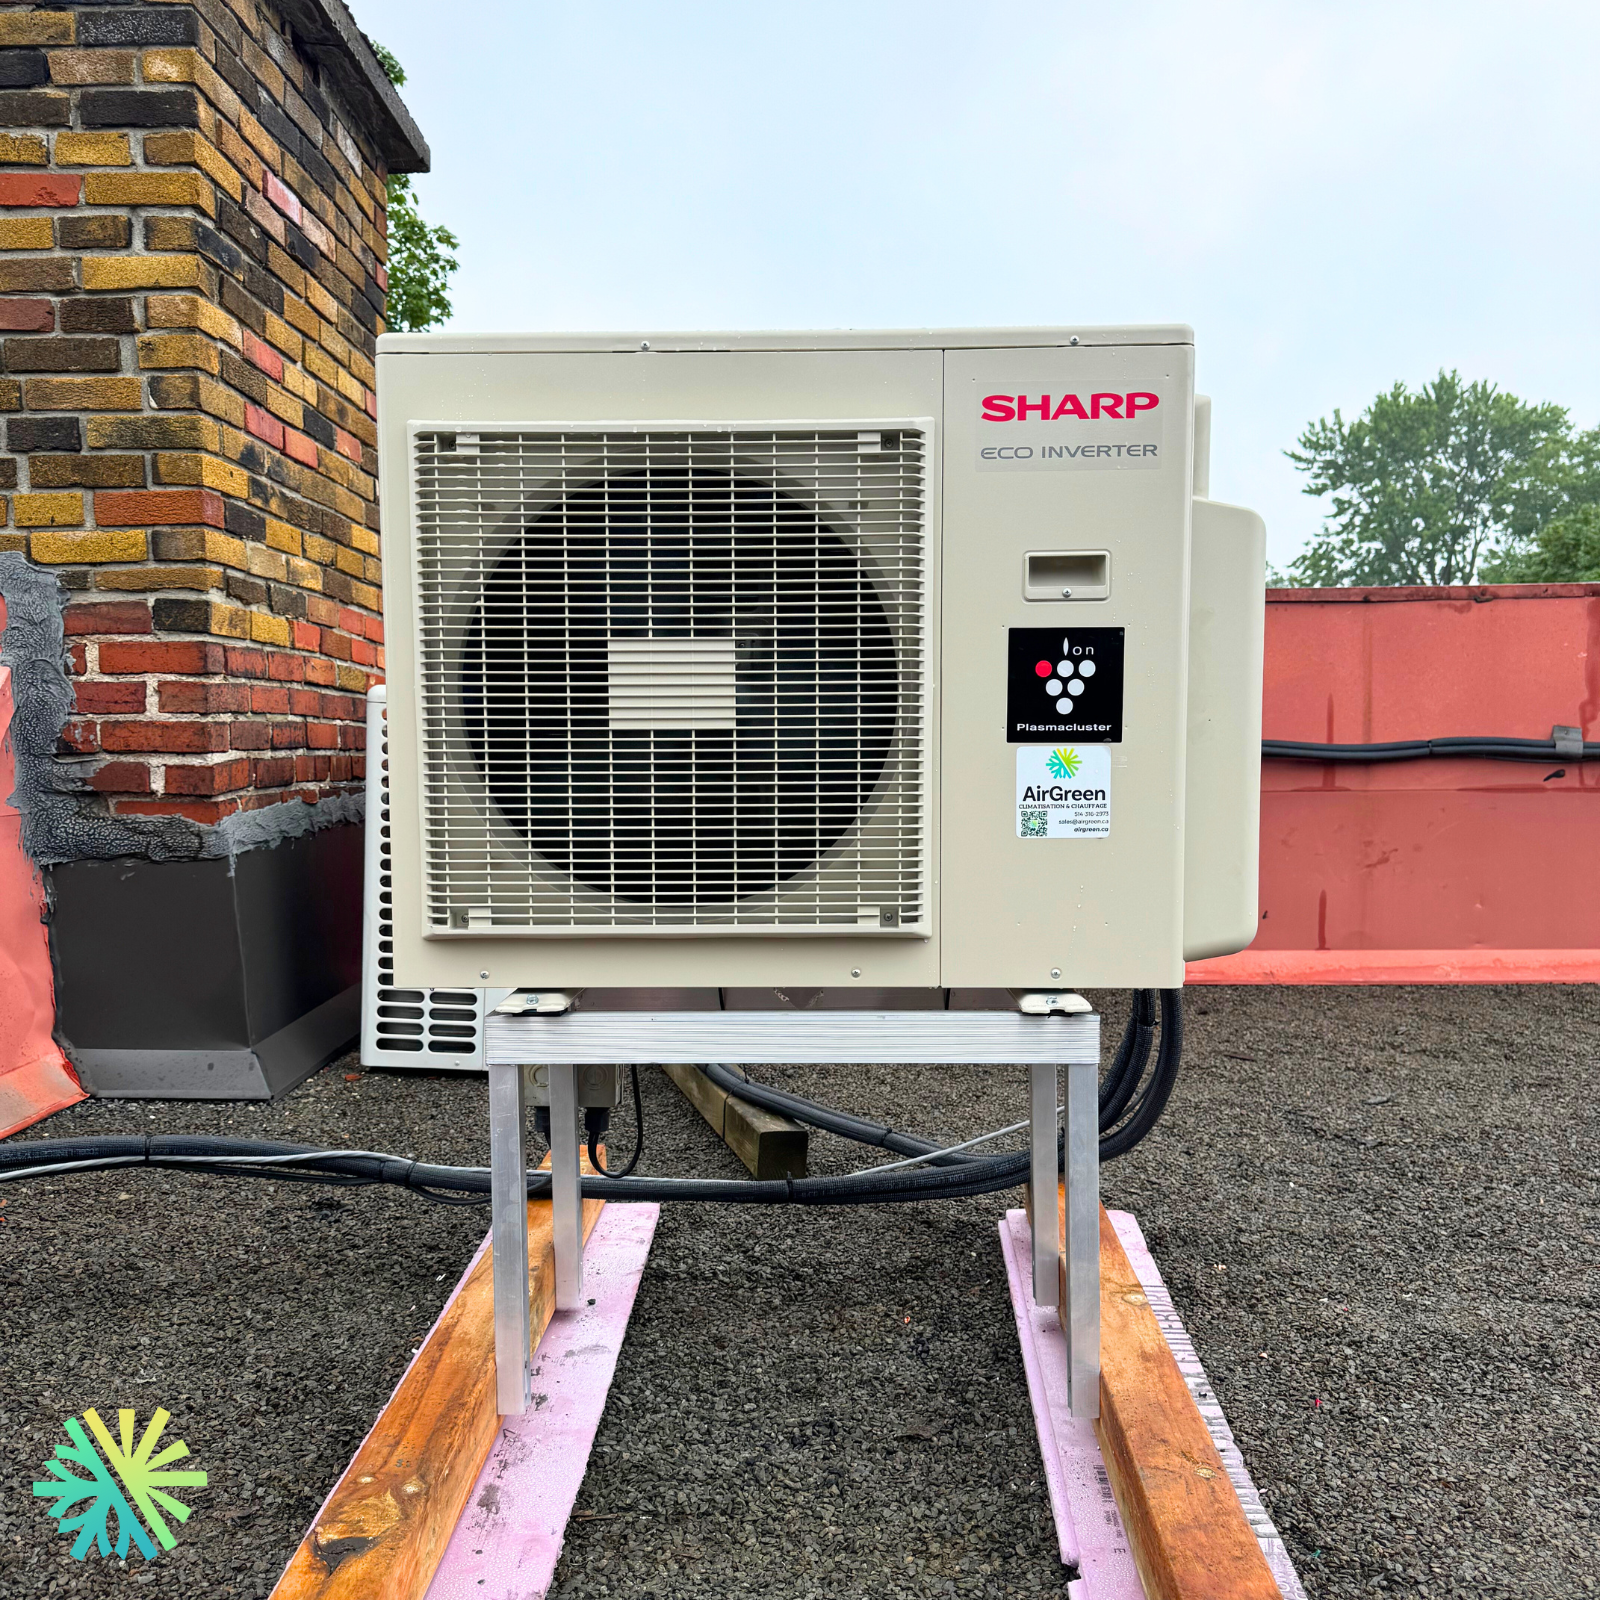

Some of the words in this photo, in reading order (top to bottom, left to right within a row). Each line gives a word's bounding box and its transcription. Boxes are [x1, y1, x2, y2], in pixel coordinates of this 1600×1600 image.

[981, 392, 1160, 422] SHARP
[980, 446, 1034, 460] ECO
[1041, 444, 1158, 459] INVERTER
[1016, 723, 1112, 732] Plasmacluster
[1022, 785, 1106, 802] AirGreen
